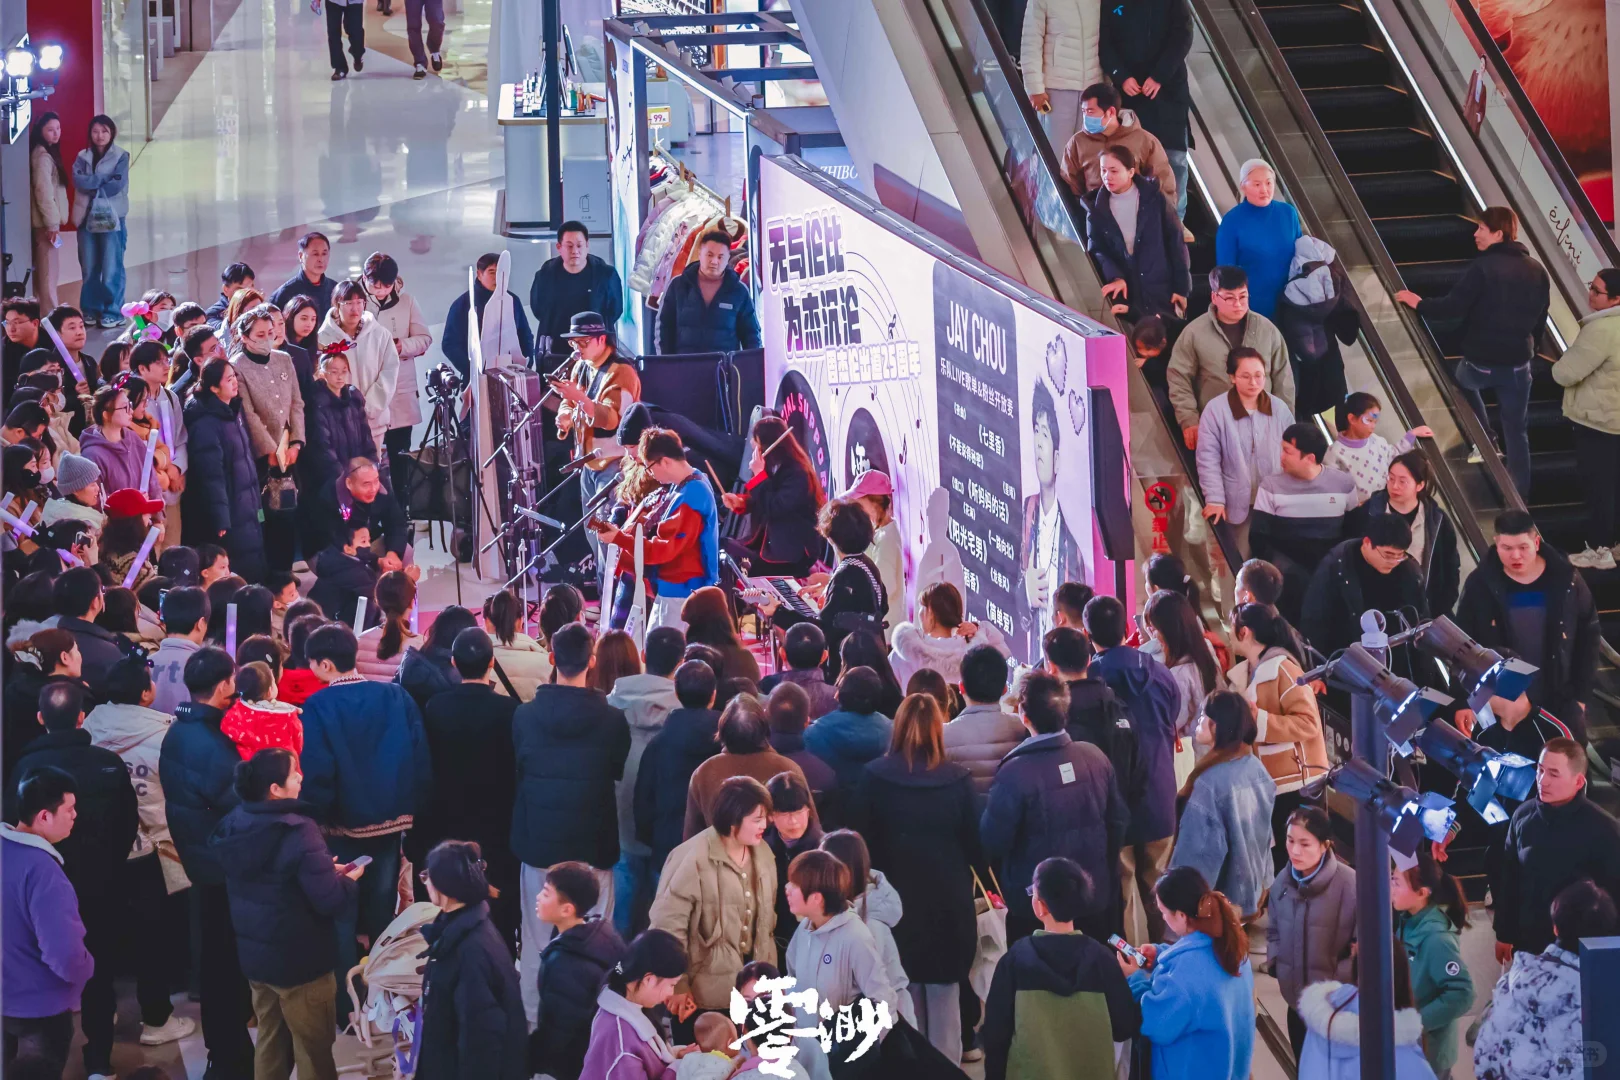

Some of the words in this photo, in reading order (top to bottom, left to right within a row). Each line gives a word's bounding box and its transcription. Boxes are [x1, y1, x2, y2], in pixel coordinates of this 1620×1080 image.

[768, 214, 845, 285] 无与伦比
[783, 284, 862, 353] 为杰沉沦
[946, 300, 969, 354] JAY
[971, 312, 1007, 376] CHOU
[826, 339, 921, 386] 周杰伦出道25周年
[940, 357, 1014, 418] 乐队LIVE歌单&粉丝开放麦
[978, 423, 1006, 458] 《七里香》
[967, 478, 1010, 524] 《听妈妈的话》
[948, 516, 988, 565] 《阳光宅男》
[988, 529, 1014, 561] 《一路向北》
[985, 598, 1014, 637] 《简单爱》
